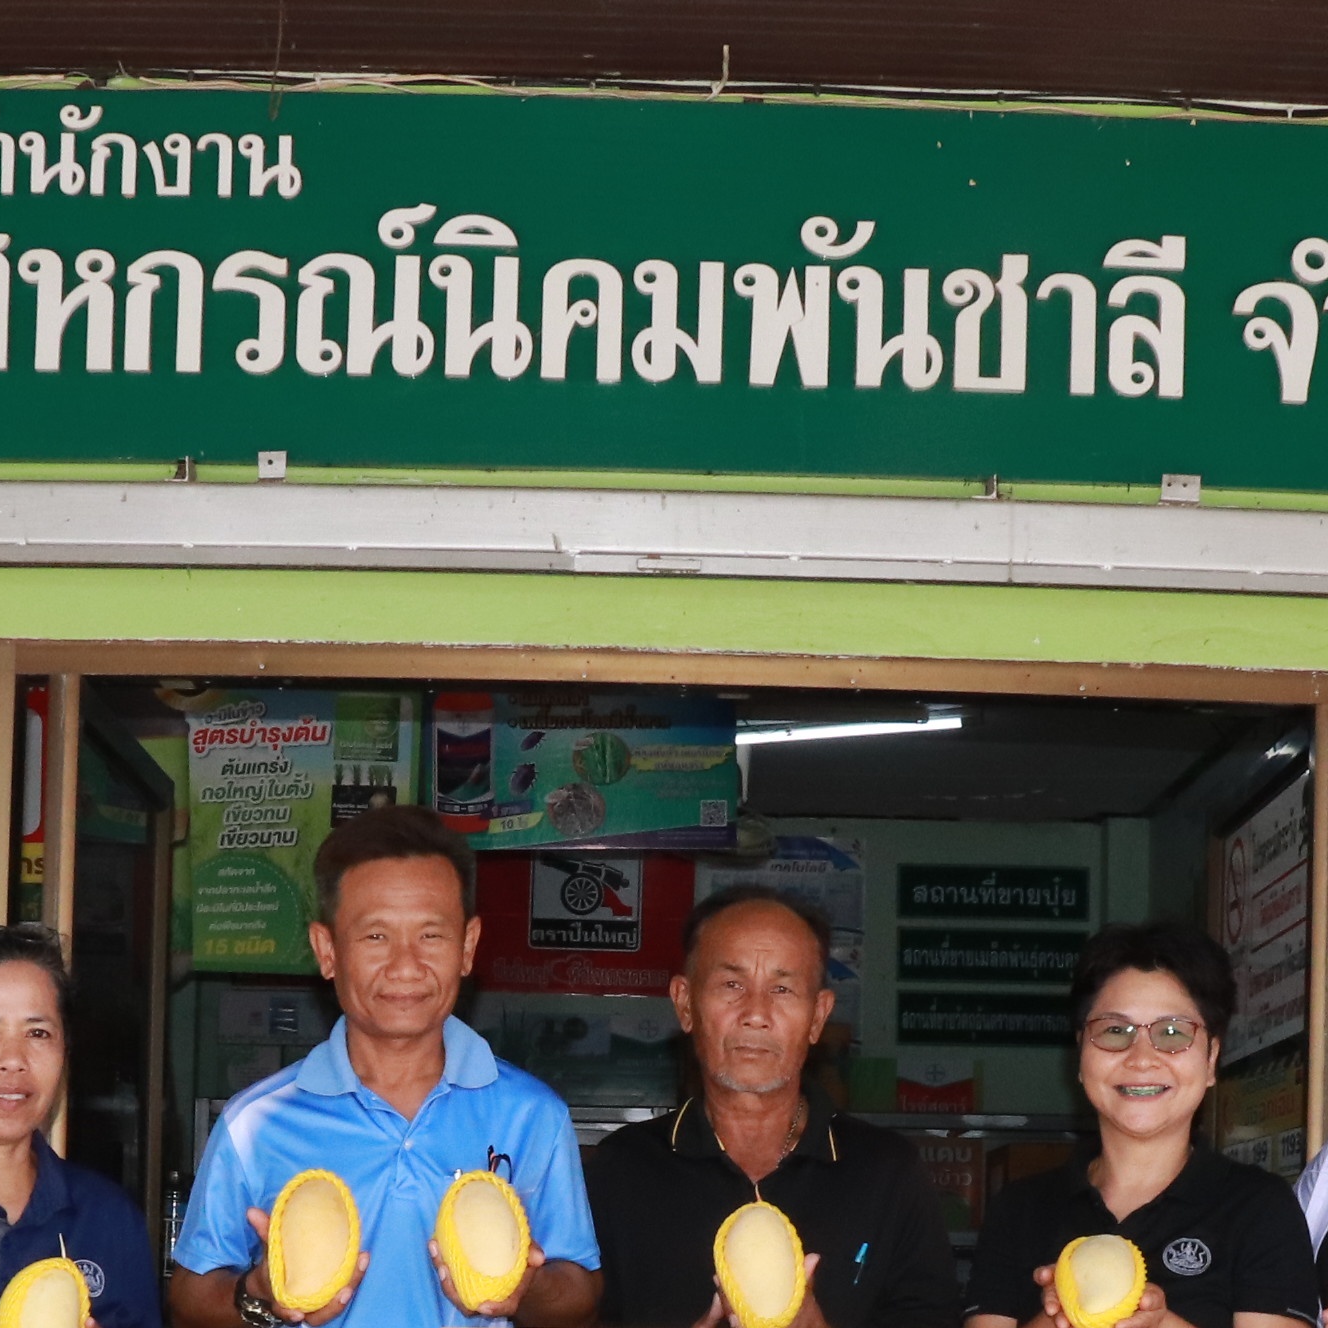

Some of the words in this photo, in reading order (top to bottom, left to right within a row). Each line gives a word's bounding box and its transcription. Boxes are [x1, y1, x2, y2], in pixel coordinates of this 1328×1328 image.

[193, 718, 328, 753] สูตรบำรุงต้น
[221, 755, 289, 776] ต้นแกร่ง
[201, 777, 264, 801] กอใหญ่
[224, 804, 288, 824] เขียวทน
[219, 827, 296, 848] เขียวนาน
[912, 870, 1077, 917] สถานที่ขายปุ๋ย
[531, 921, 638, 948] ตราปืนใหญ่
